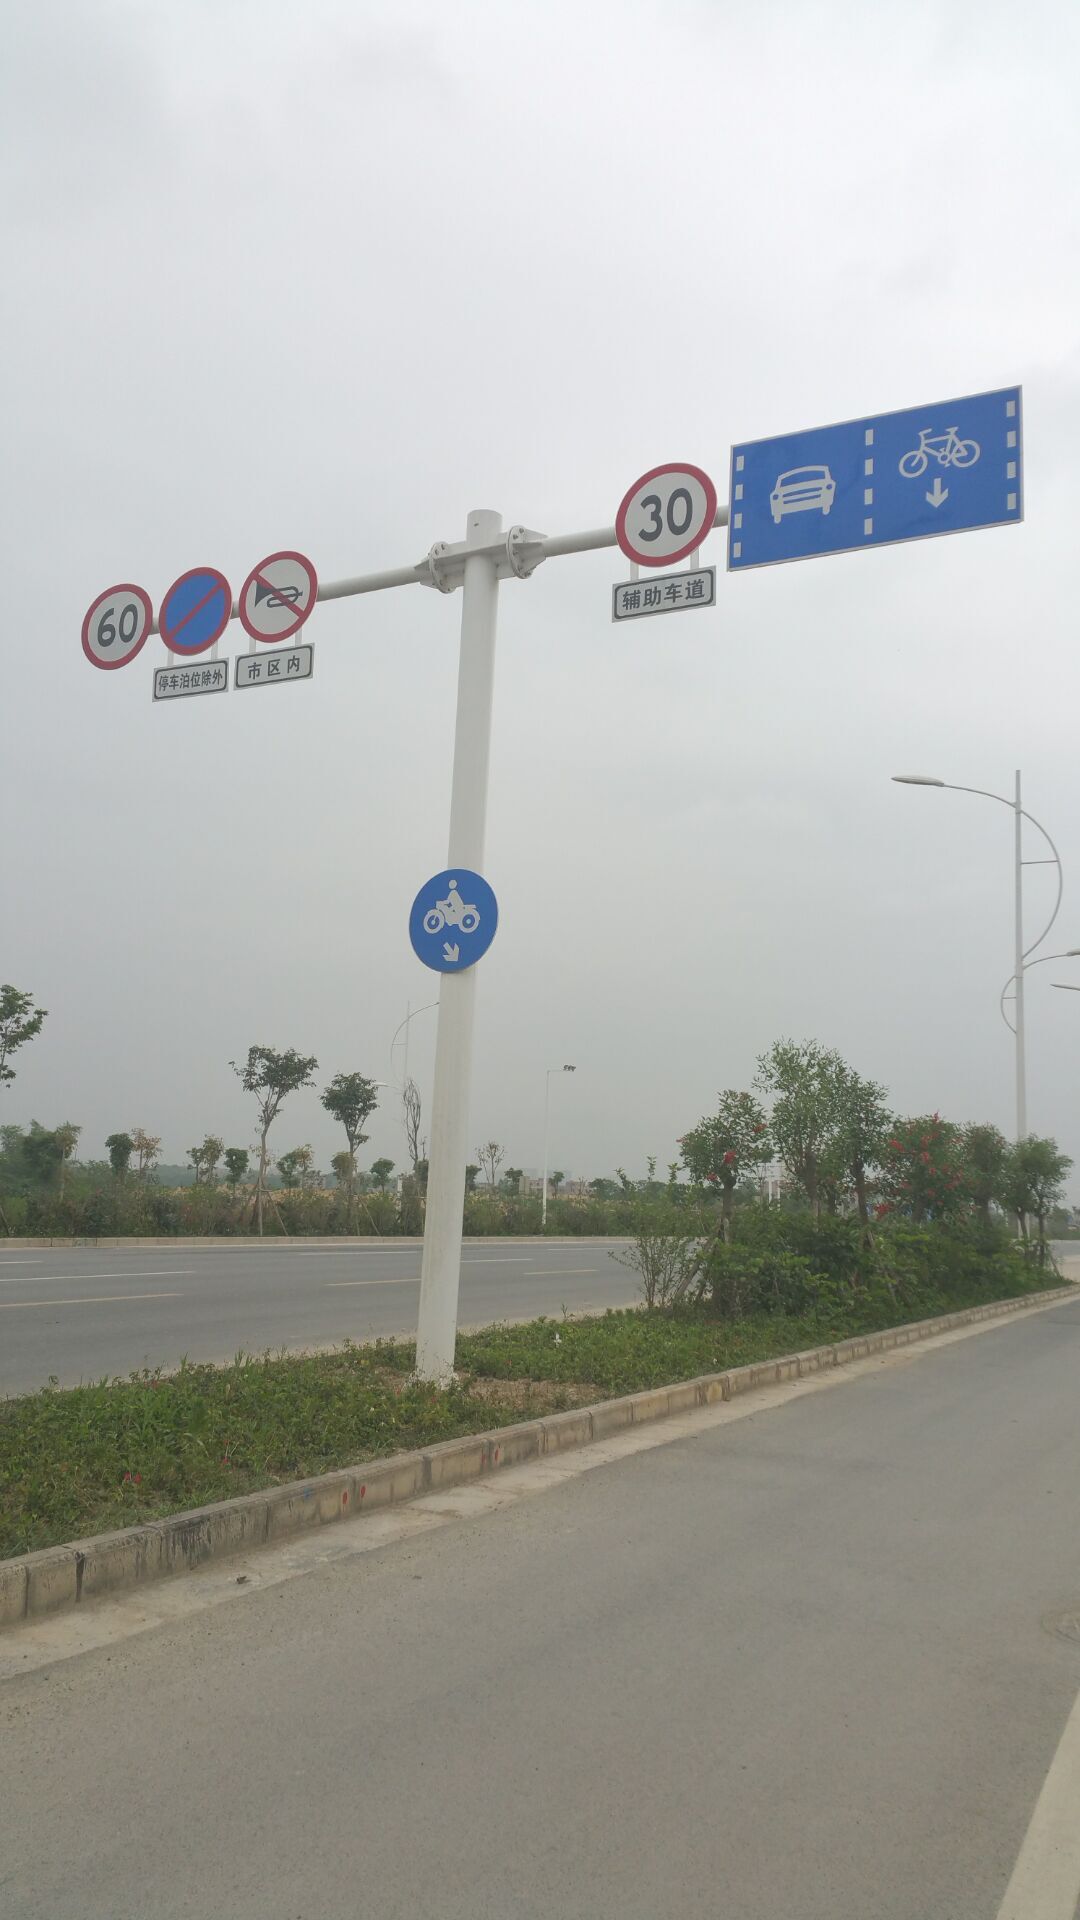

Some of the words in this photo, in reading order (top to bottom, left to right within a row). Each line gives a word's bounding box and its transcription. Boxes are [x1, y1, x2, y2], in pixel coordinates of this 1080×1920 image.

[638, 488, 693, 542] 30
[622, 579, 705, 610] 辅助车道
[97, 603, 139, 647] 60
[158, 669, 223, 692] 停车泊位除外
[248, 655, 301, 681] 市区内
